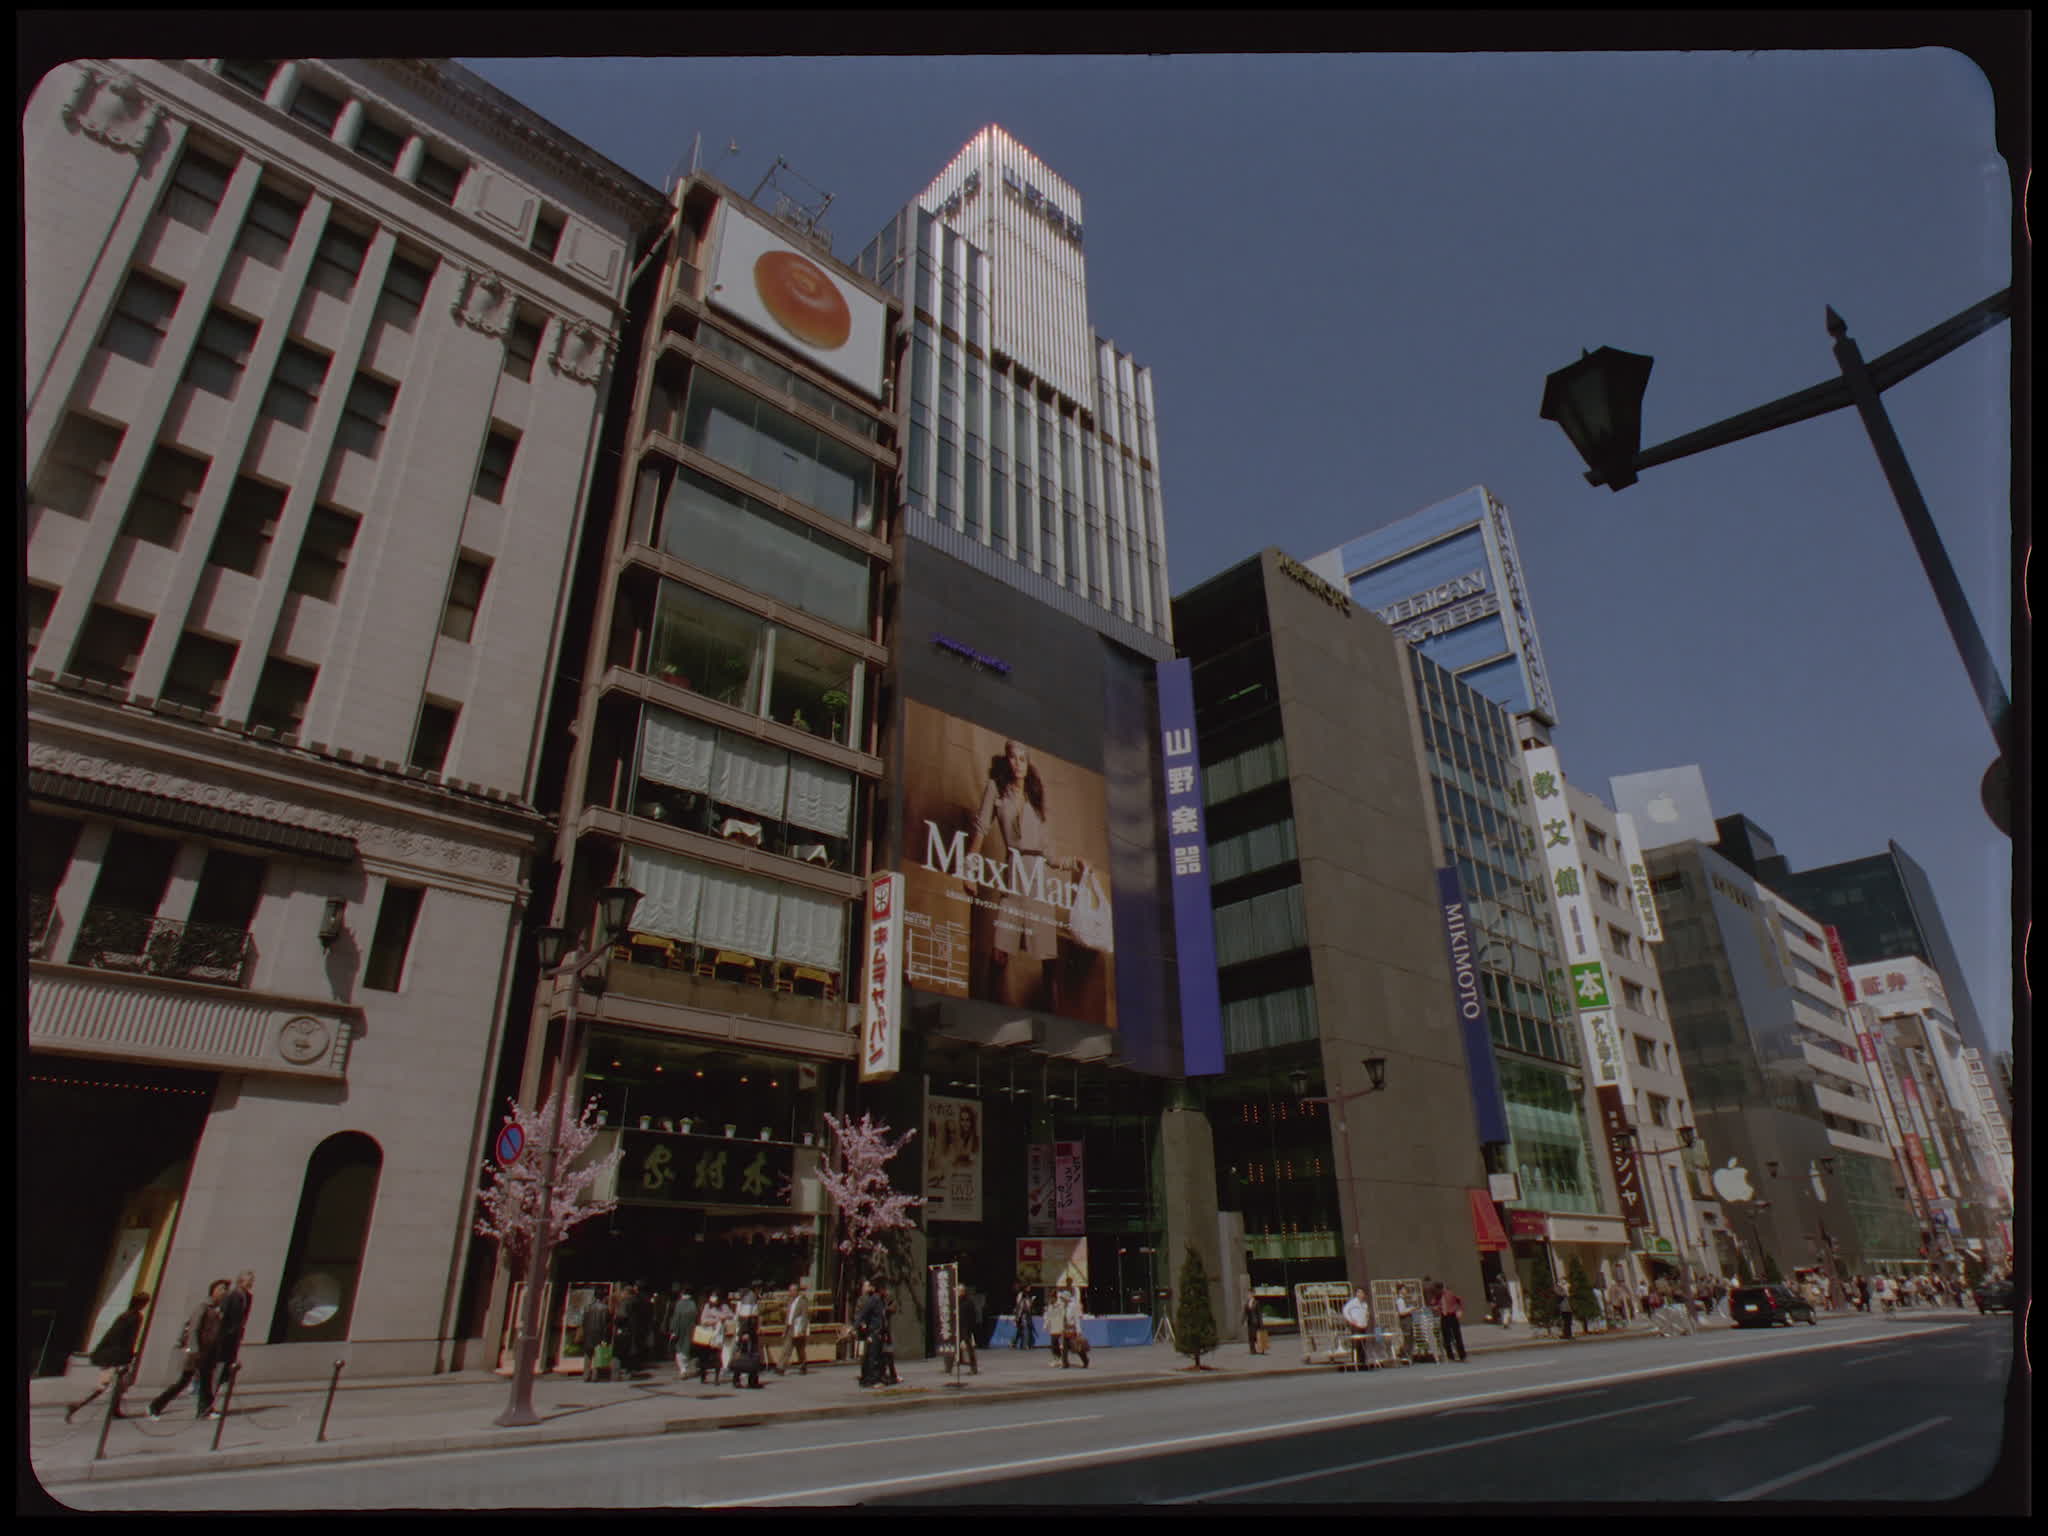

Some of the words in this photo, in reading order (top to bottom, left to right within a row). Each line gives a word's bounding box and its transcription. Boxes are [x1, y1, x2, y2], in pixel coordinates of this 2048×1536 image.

[1376, 569, 1484, 623] MERICAN
[1165, 728, 1202, 876] 山野楽器
[921, 820, 1088, 910] MaxMar
[1445, 903, 1481, 1019] MIKIMOTO
[1575, 969, 1604, 1001] 本
